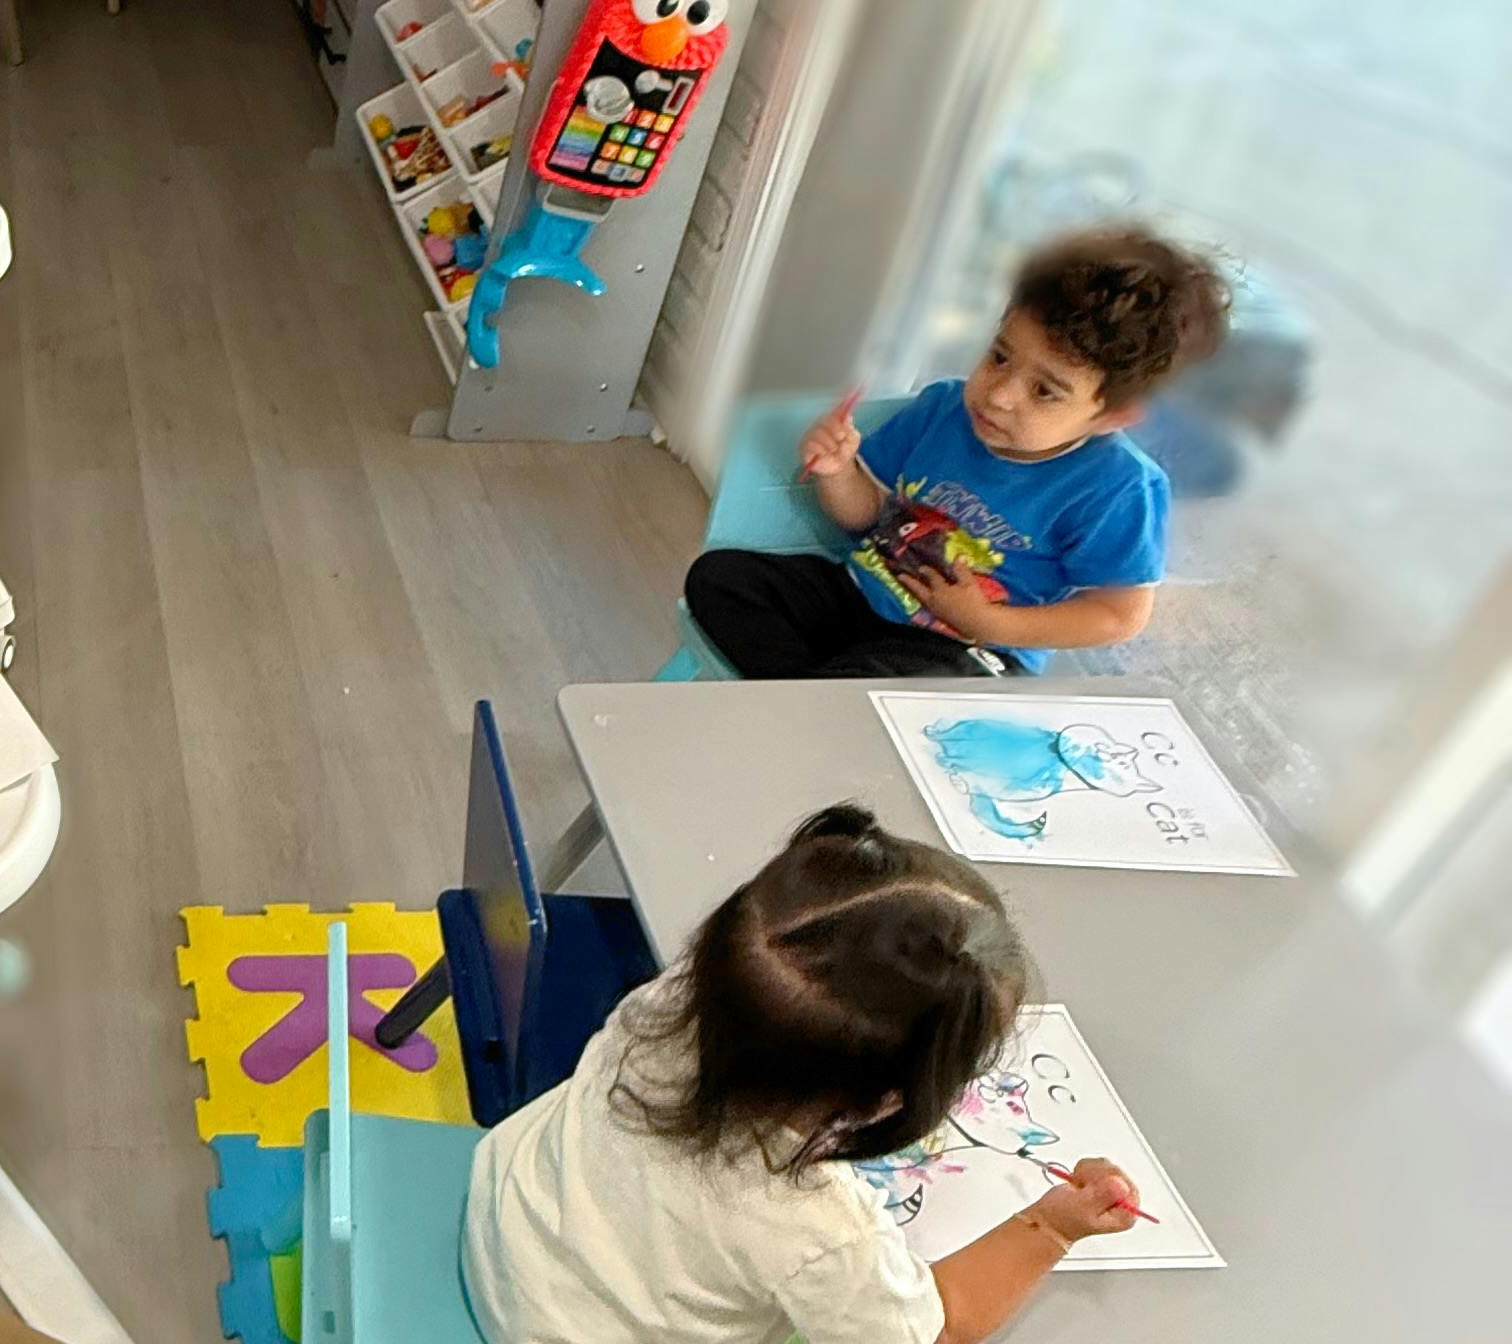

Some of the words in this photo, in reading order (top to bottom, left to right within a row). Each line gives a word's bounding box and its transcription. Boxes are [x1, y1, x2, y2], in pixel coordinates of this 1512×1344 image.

[1141, 732, 1179, 767] Cc
[1146, 802, 1190, 845] Cat
[226, 953, 439, 1085] K
[1031, 1053, 1077, 1104] Cc
